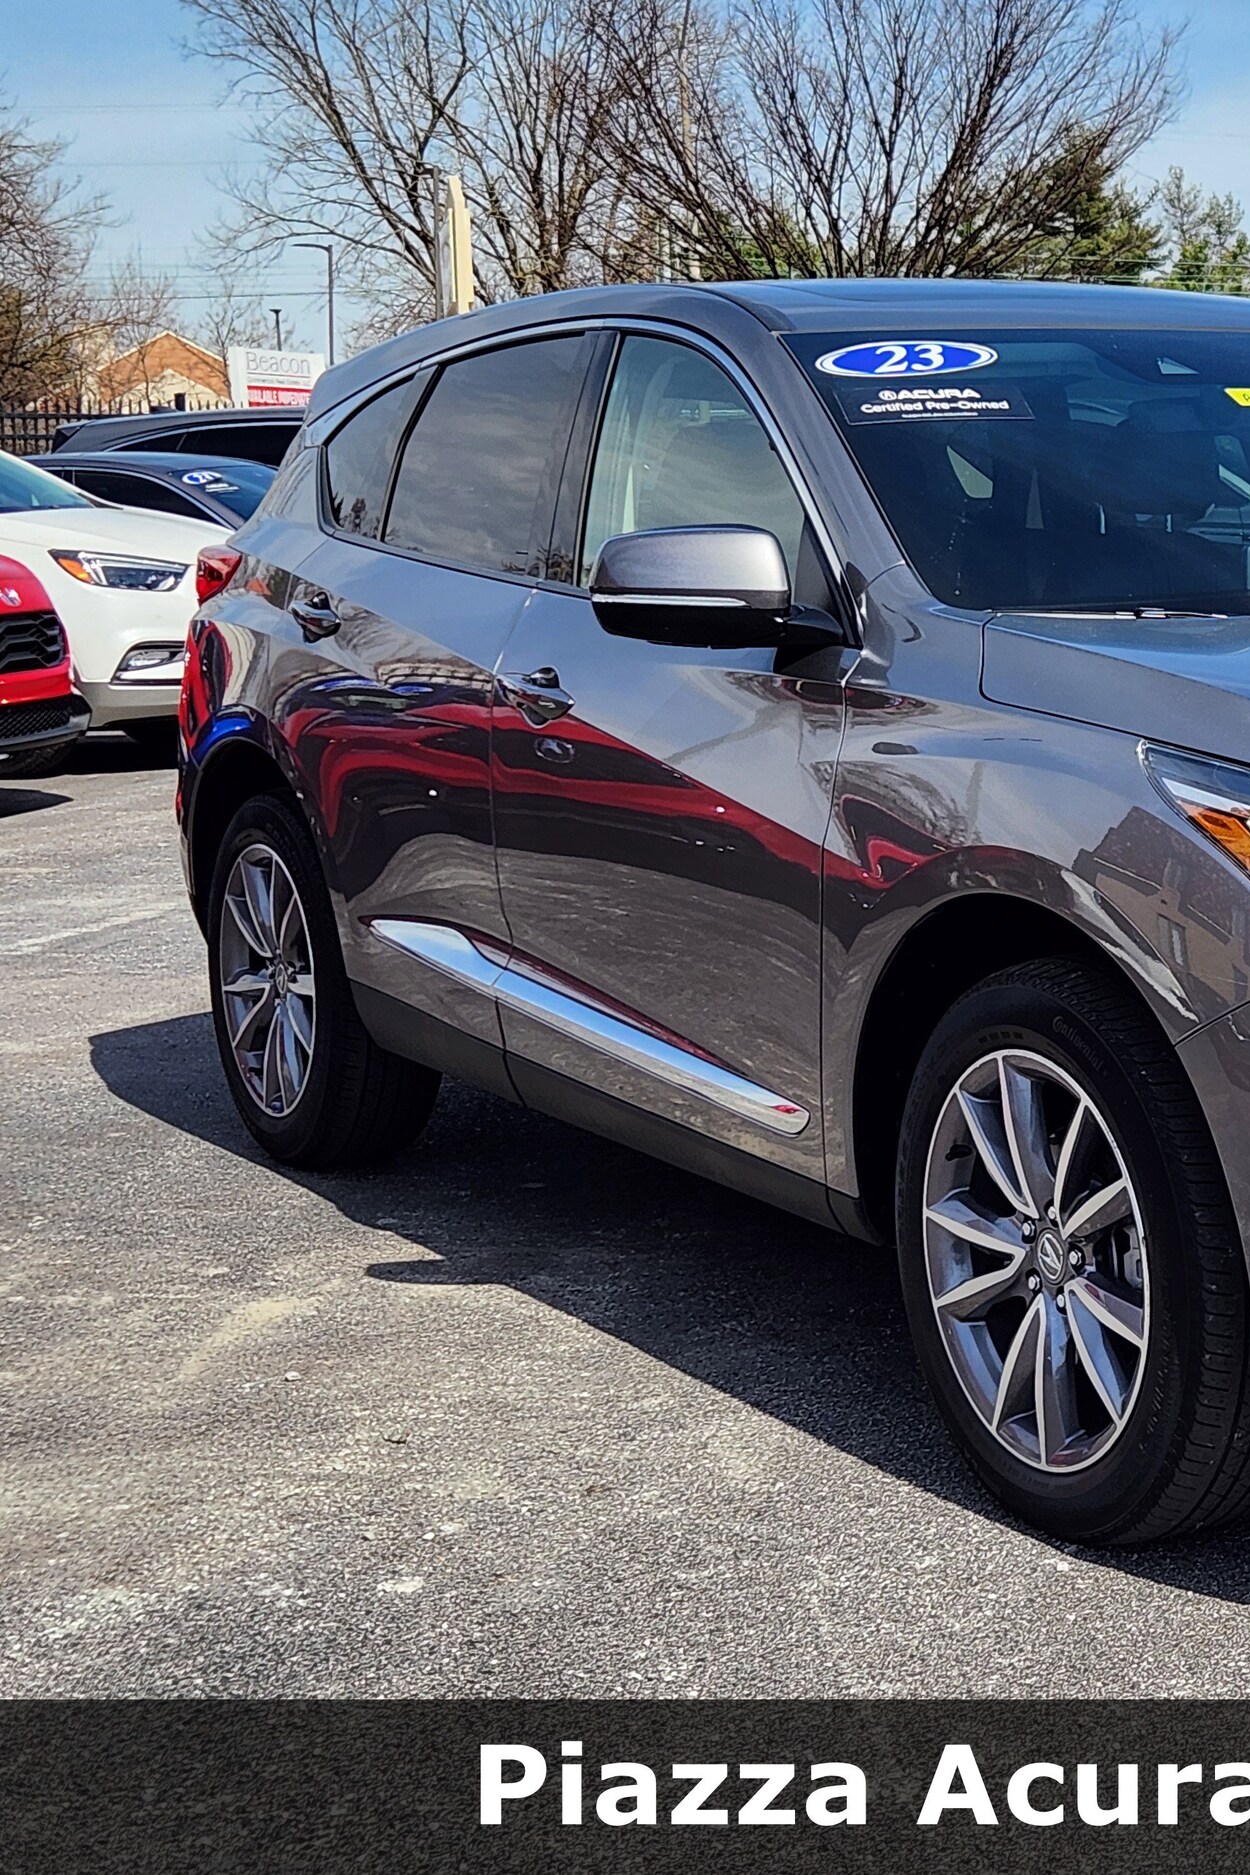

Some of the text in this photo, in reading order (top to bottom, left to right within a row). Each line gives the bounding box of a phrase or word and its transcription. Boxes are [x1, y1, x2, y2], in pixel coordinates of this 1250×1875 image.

[246, 352, 310, 374] Beacon
[874, 344, 945, 373] 23
[898, 388, 981, 400] ACURA
[860, 400, 1010, 413] Certified Pre-Owned
